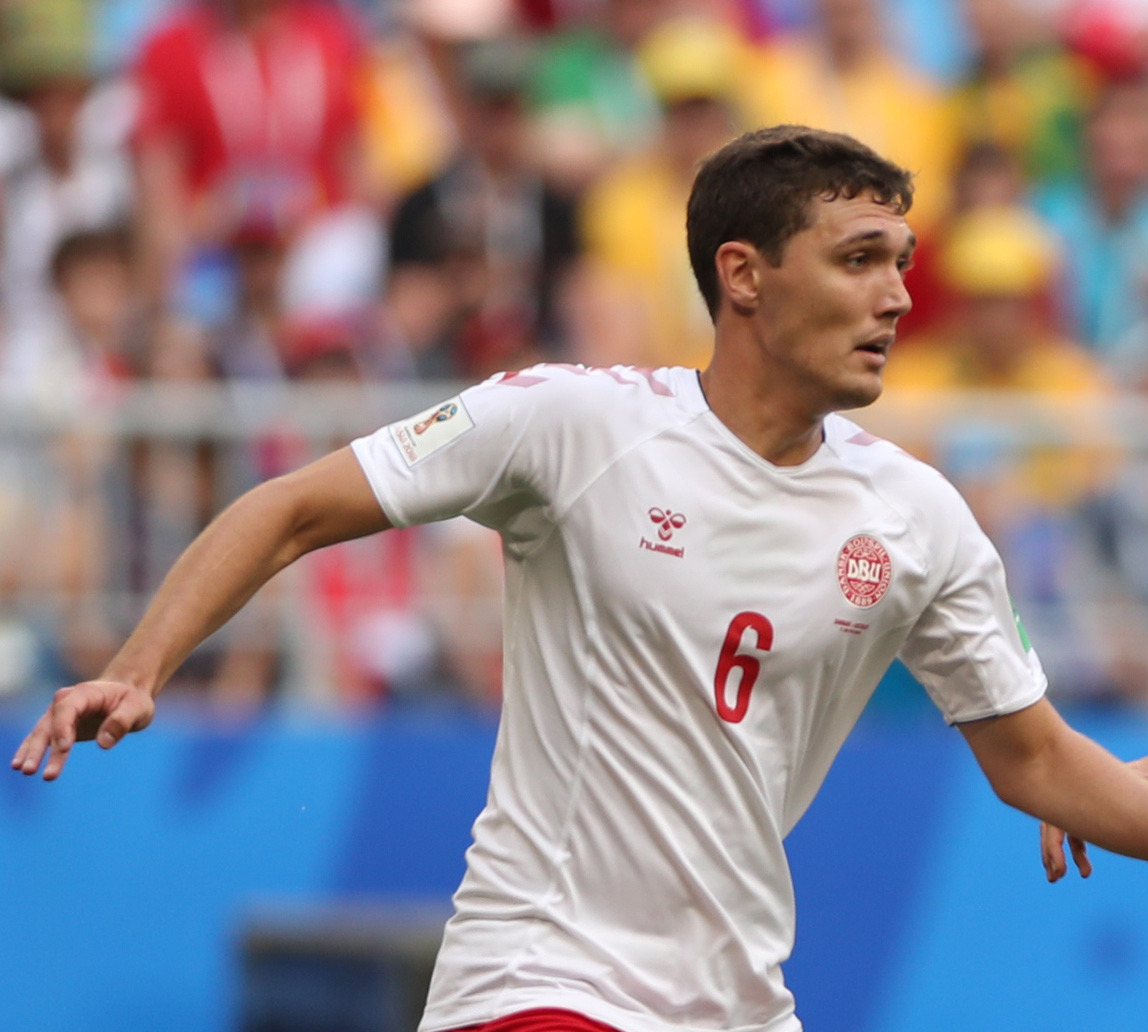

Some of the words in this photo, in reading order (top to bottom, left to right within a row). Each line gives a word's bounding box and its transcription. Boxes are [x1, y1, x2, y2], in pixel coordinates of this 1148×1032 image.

[640, 536, 685, 559] hummel
[847, 558, 881, 583] DBU
[714, 611, 774, 724] 6
